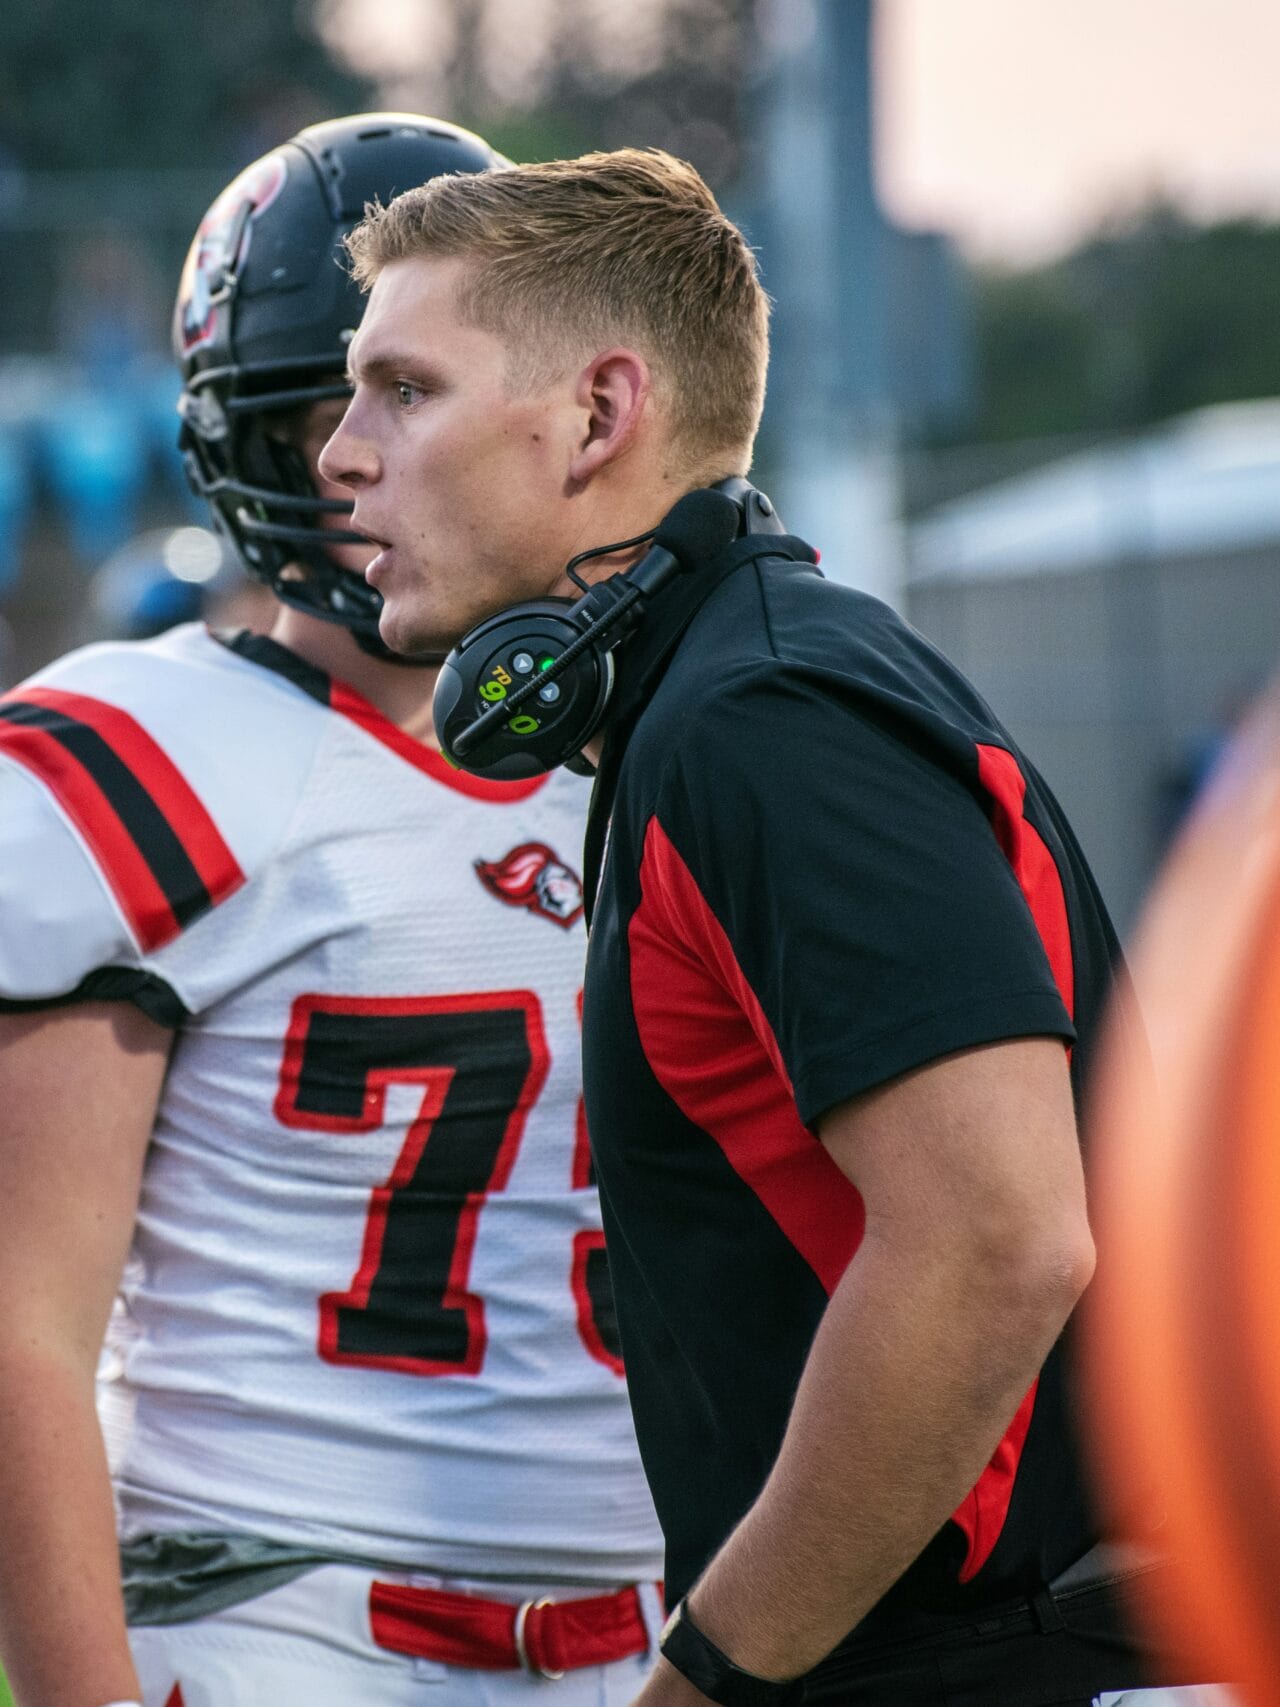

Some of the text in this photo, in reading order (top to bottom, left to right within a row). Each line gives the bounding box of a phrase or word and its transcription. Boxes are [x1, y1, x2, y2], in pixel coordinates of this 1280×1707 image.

[492, 665, 512, 685] TD
[479, 681, 539, 735] 90
[273, 989, 626, 1378] 7
